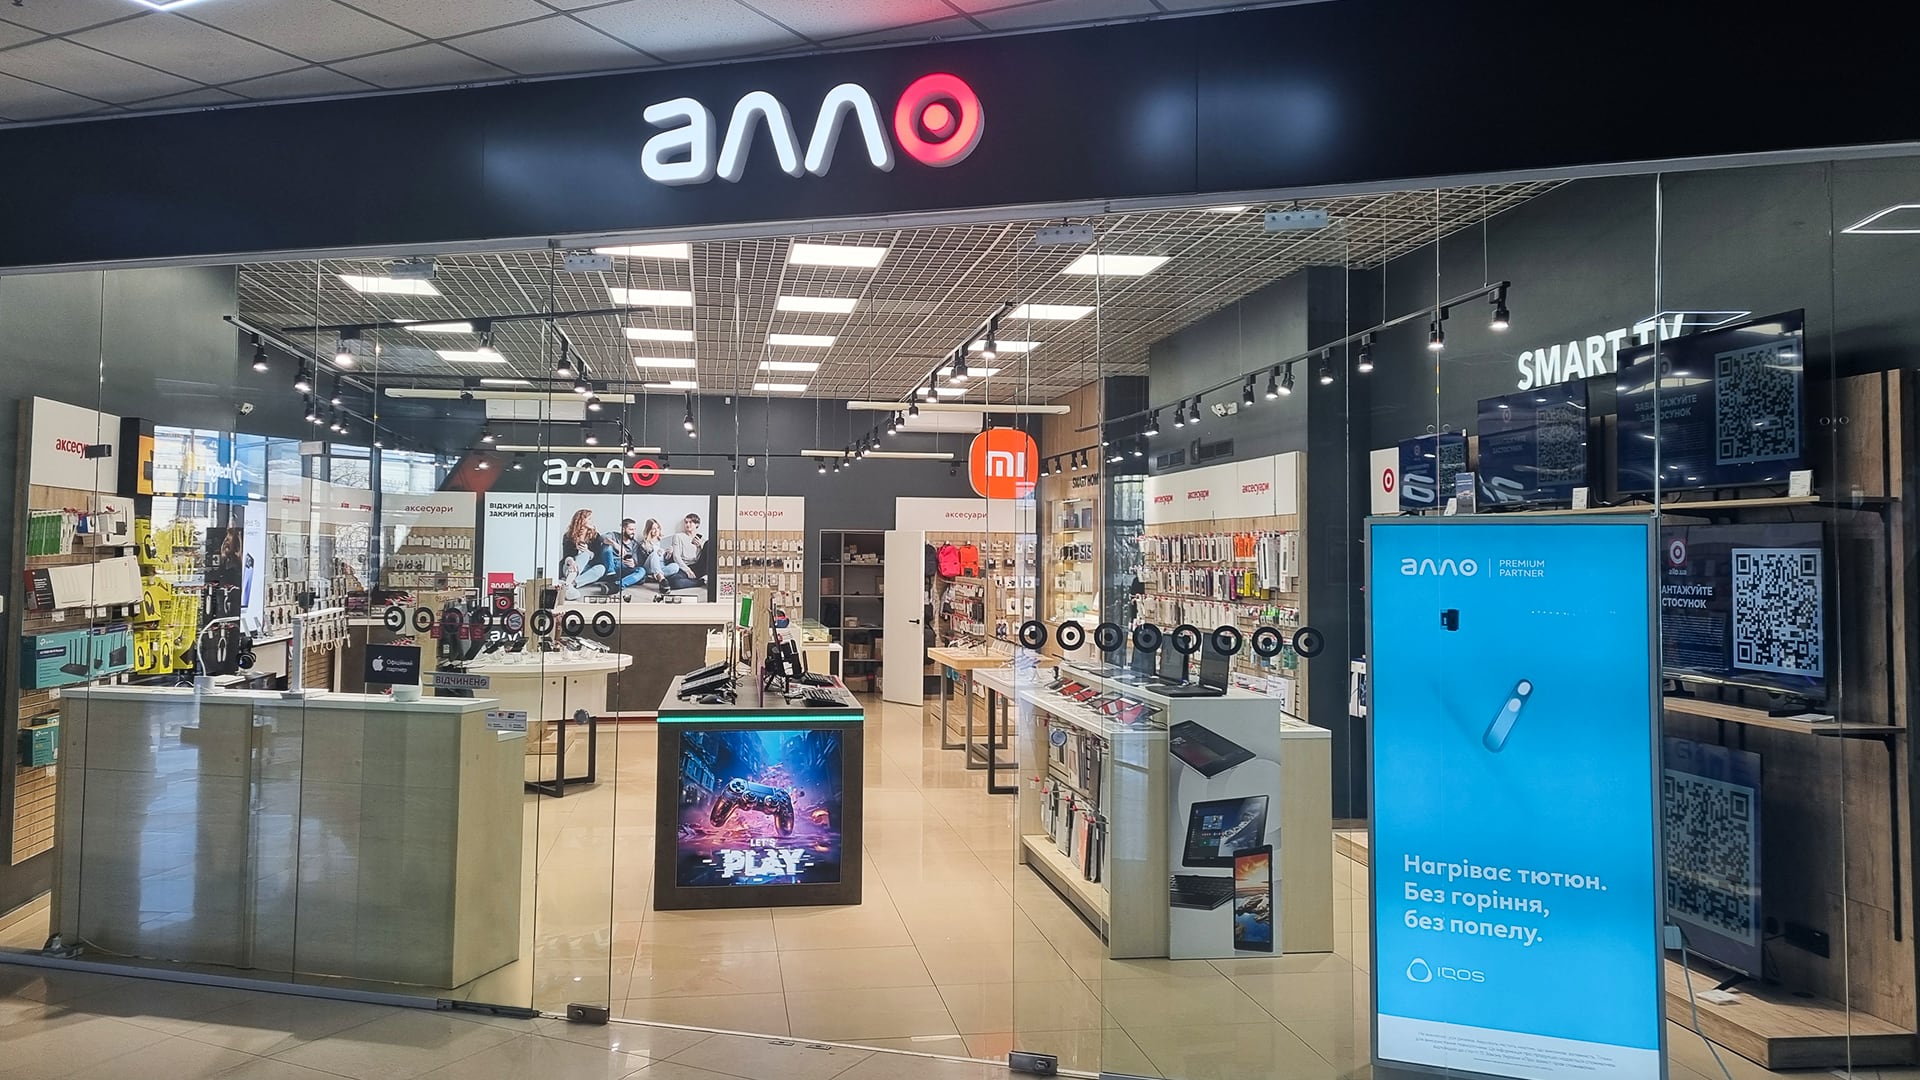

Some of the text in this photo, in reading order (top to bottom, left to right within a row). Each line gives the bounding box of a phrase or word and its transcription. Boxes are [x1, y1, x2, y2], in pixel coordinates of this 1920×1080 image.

[1517, 314, 1684, 391] SMART TV
[1634, 393, 1697, 412] ЗАВАТАЖУЙТЕ
[1640, 407, 1692, 423] ЗАСОСУНОК
[56, 438, 92, 460] аксесу
[405, 504, 454, 514] аксесуари
[489, 501, 523, 510] ВІДКРИЙ
[739, 509, 784, 519] аксесуари
[945, 511, 988, 521] аксесуари
[1499, 559, 1545, 568] PREMIUM
[1499, 569, 1545, 578] PARTNER
[1661, 584, 1713, 596] АНТАЖУЙТЕ
[1661, 598, 1707, 609] СТОСУНОК
[435, 675, 488, 687] ВІДЧИНЕНО
[719, 849, 806, 878] PLAY
[1403, 854, 1608, 891] Нагріває тютюн.
[1404, 882, 1550, 918] Без горіння,
[1404, 909, 1544, 947] без попелу.
[1437, 966, 1485, 983] IQOS
